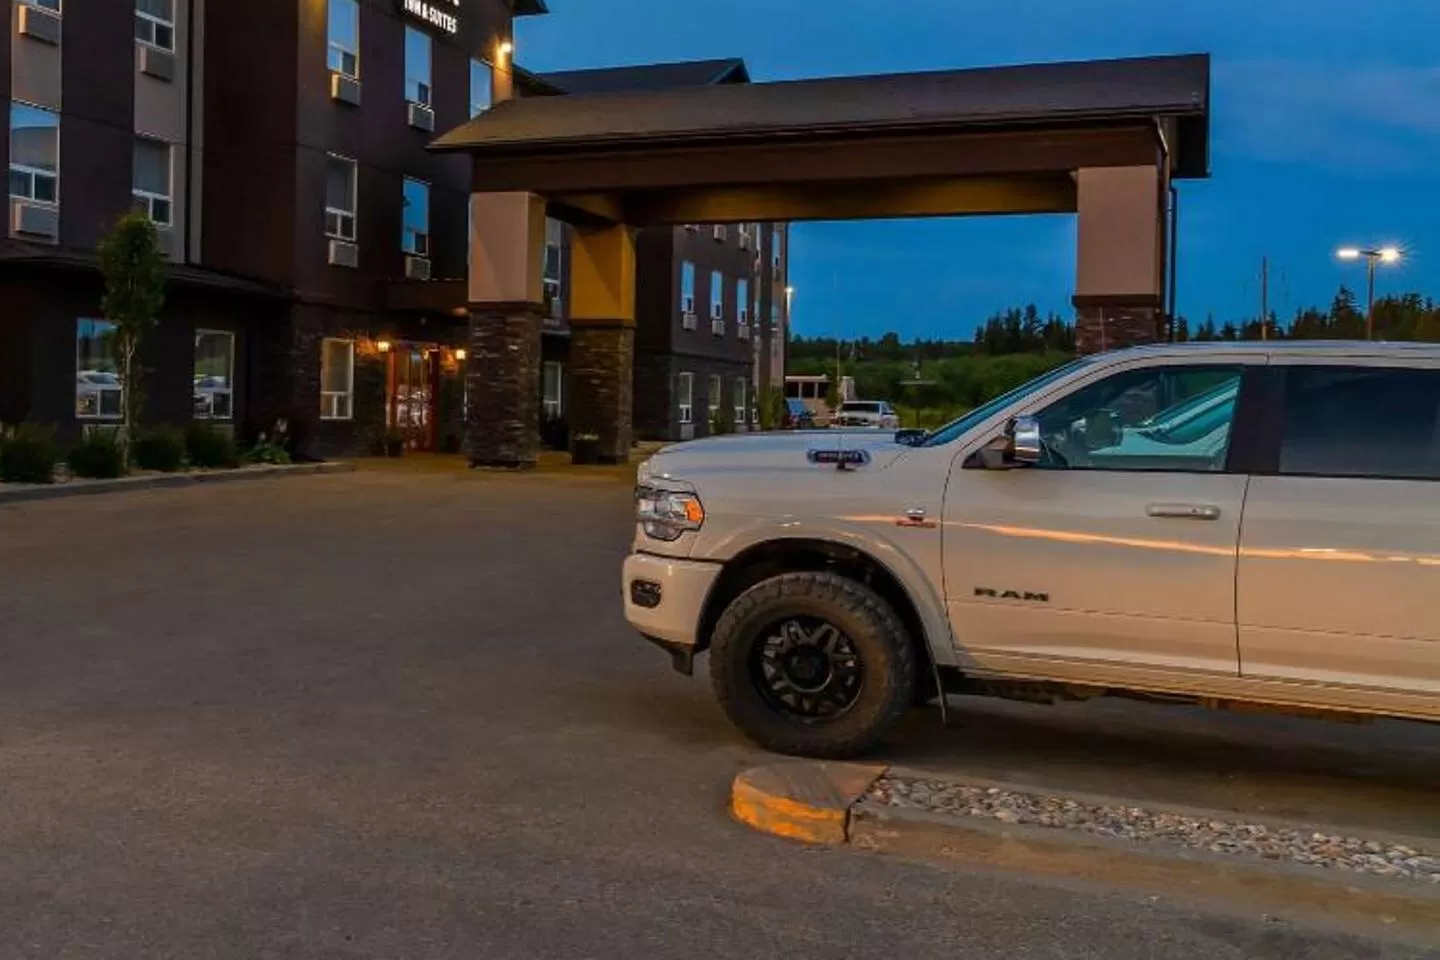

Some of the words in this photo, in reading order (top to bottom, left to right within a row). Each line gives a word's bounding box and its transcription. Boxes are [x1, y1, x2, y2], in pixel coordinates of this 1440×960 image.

[422, 3, 429, 19] &
[429, 6, 457, 33] SUITES
[973, 586, 1049, 602] RAM
